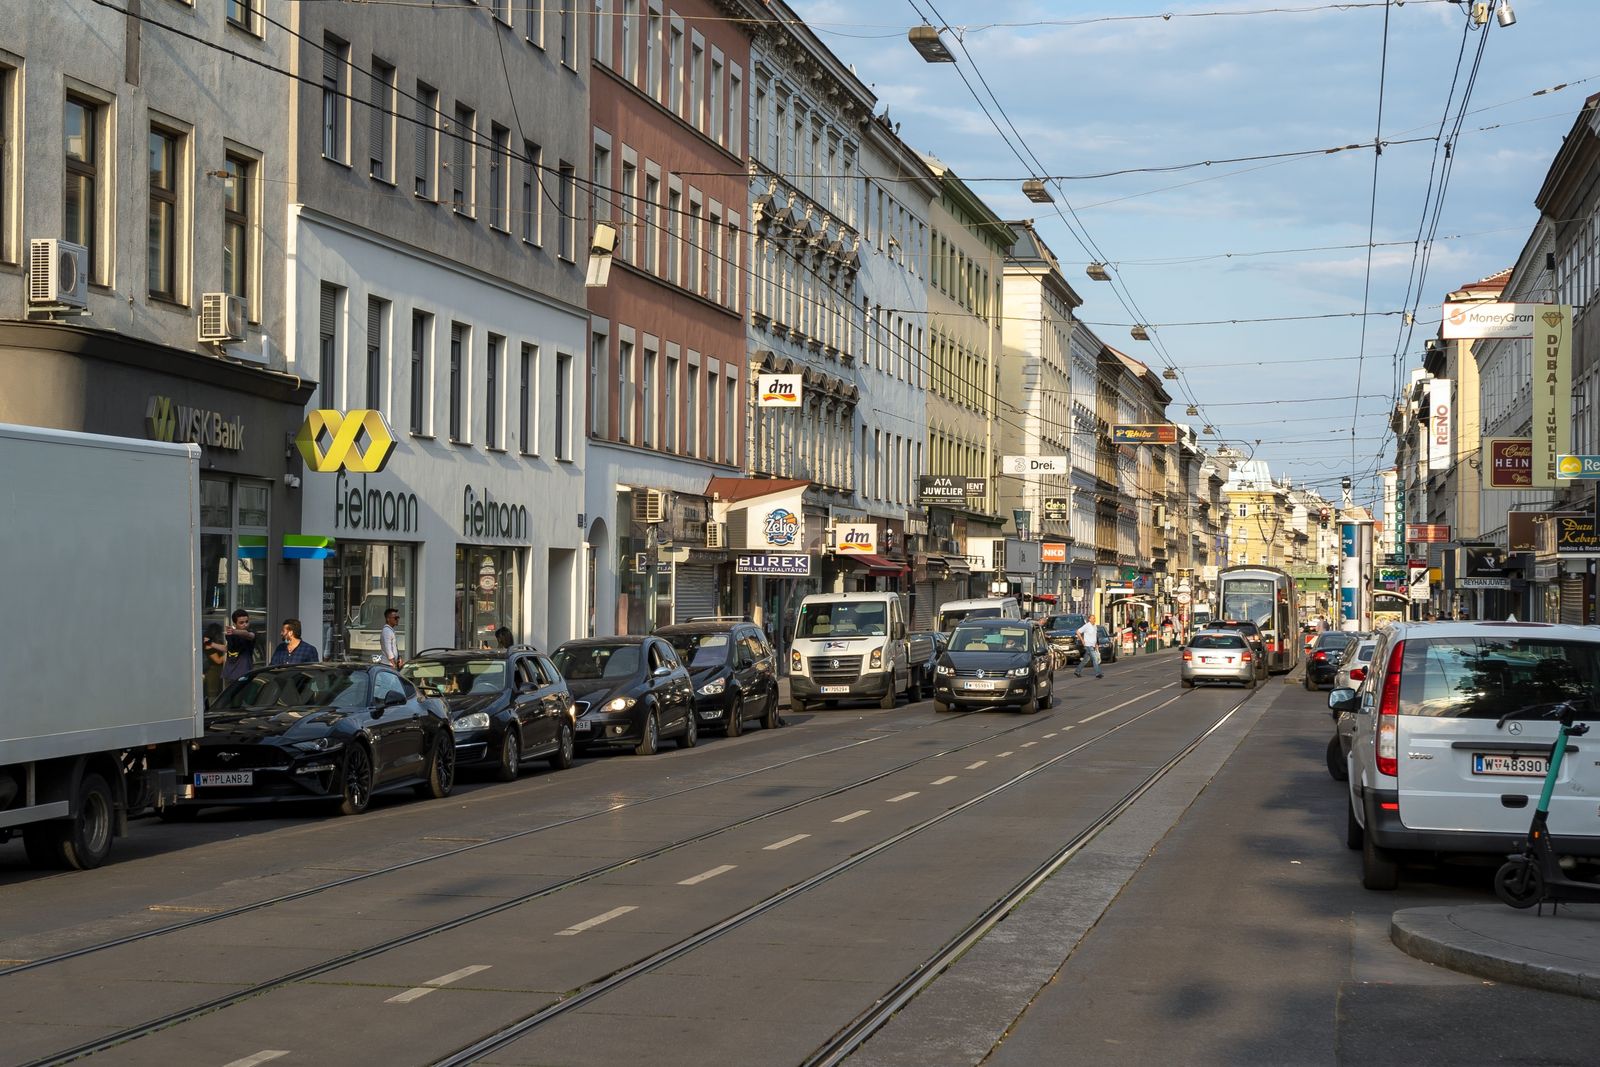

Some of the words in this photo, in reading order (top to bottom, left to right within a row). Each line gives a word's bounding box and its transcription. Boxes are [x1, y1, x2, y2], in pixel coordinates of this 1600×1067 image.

[1546, 334, 1558, 396] DUBAI
[768, 379, 793, 394] dm
[177, 404, 210, 445] WSK
[212, 412, 245, 450] Bank
[1436, 404, 1448, 445] RENO
[1546, 407, 1557, 480] JUWELIER
[1030, 460, 1055, 470] Drei.
[934, 478, 952, 486] ATA
[922, 487, 963, 496] JUWELIER
[335, 469, 418, 532] fielmann
[463, 484, 527, 539] fielmann
[1562, 518, 1593, 531] Duru
[845, 528, 870, 543] dm
[1558, 531, 1597, 544] Kebap
[1044, 549, 1064, 557] NKD
[739, 556, 808, 568] BUREK
[1484, 759, 1494, 770] W
[1503, 760, 1542, 772] 48390
[201, 775, 208, 784] W
